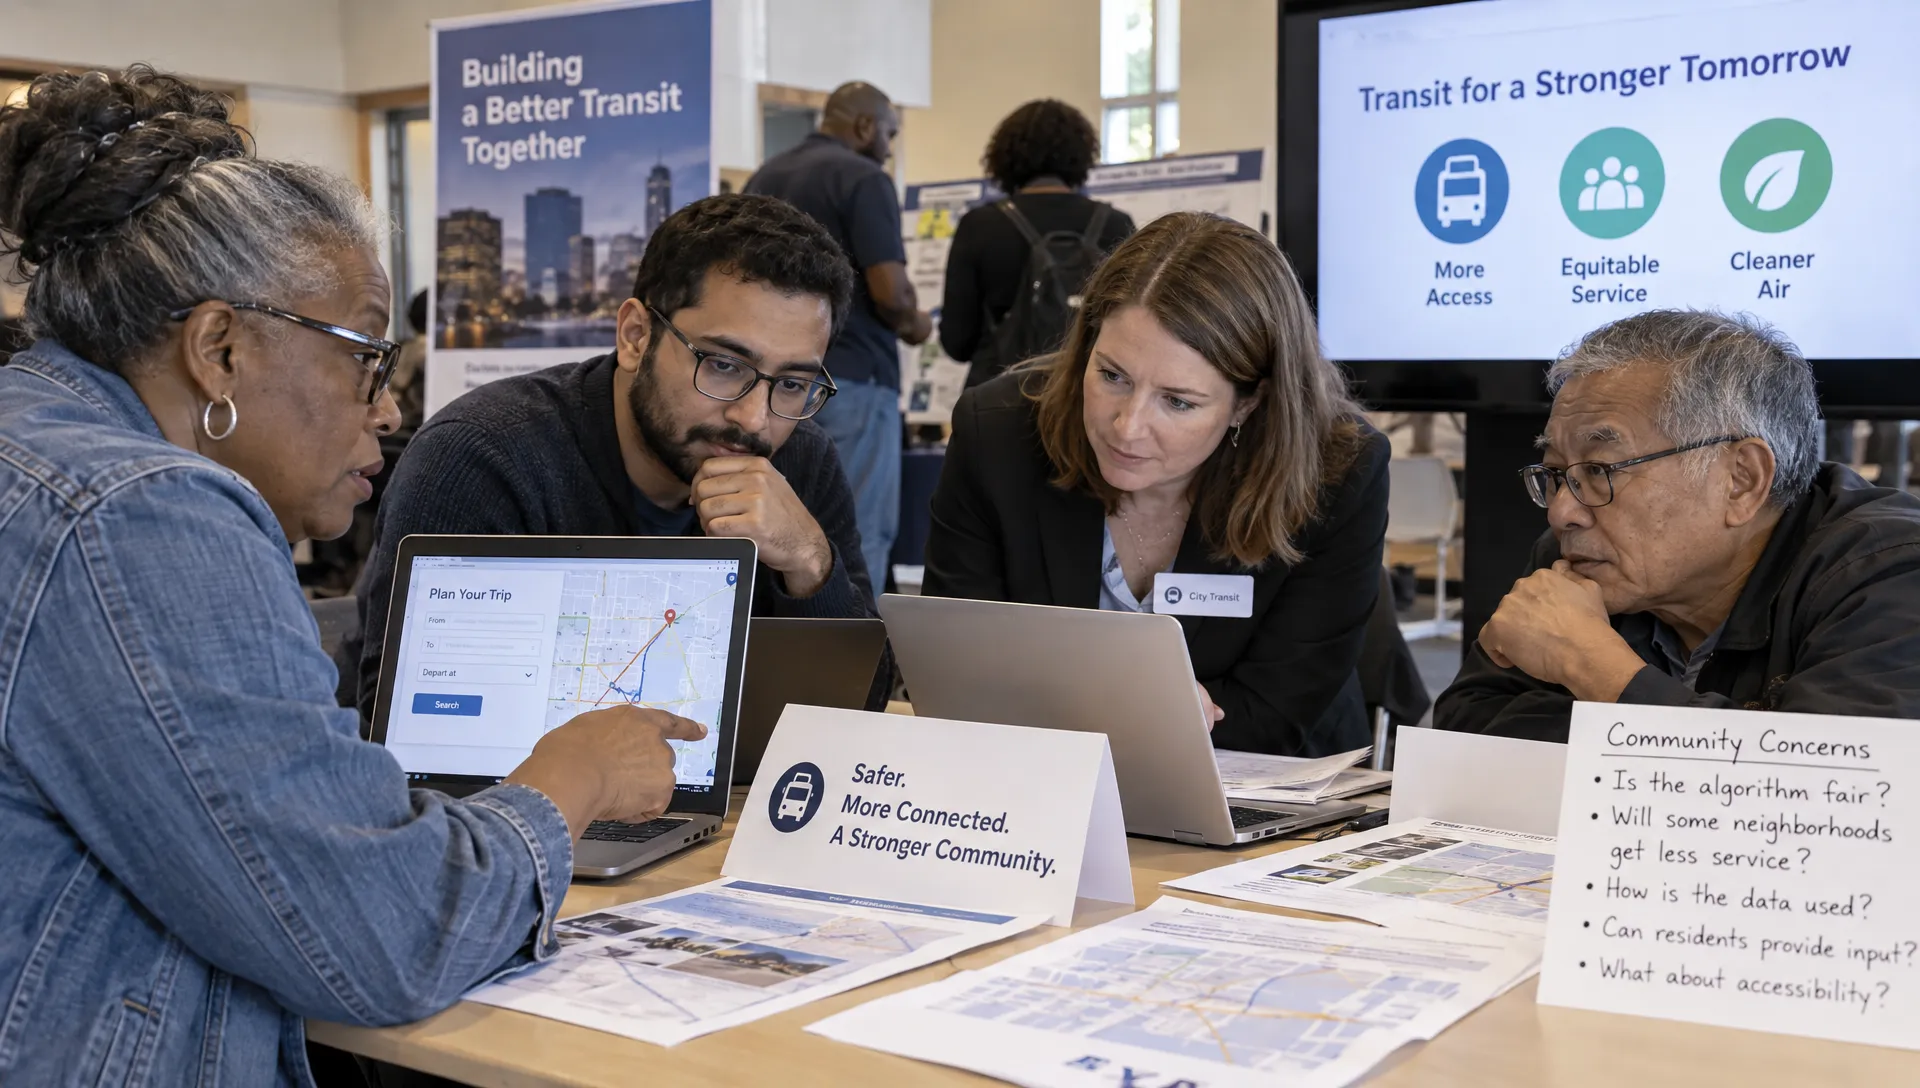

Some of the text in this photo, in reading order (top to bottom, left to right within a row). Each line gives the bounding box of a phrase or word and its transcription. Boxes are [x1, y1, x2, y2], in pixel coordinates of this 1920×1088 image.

[463, 51, 582, 87] Building
[1359, 45, 1851, 111] Transit for a Stronger Tomorrow
[462, 82, 682, 126] a Better Transit
[461, 131, 586, 170] Together
[1435, 261, 1484, 278] More
[1562, 255, 1659, 280] Equitable
[1731, 251, 1815, 270] Cleaner
[1426, 289, 1492, 305] Access
[1572, 284, 1647, 303] Service
[1758, 279, 1790, 298] Air
[430, 588, 511, 602] Plan Your Trip
[1189, 592, 1240, 602] City Transit
[426, 641, 434, 649] To
[422, 668, 447, 678] Depart
[434, 700, 460, 710] Search
[1608, 722, 1870, 764] Community Concerns
[852, 763, 905, 787] Safer.
[1613, 770, 1890, 807] Is the algorithm fair?
[841, 794, 1008, 833] More Connected.
[1612, 806, 1892, 844] Will some neighborhoods
[829, 826, 1055, 878] A Stronger Community.
[1611, 840, 1810, 873] get less service?
[1607, 877, 1872, 919] How is the data used?
[1603, 916, 1917, 970] Can residents provide input?
[1601, 958, 1890, 1014] What about accessibility?
